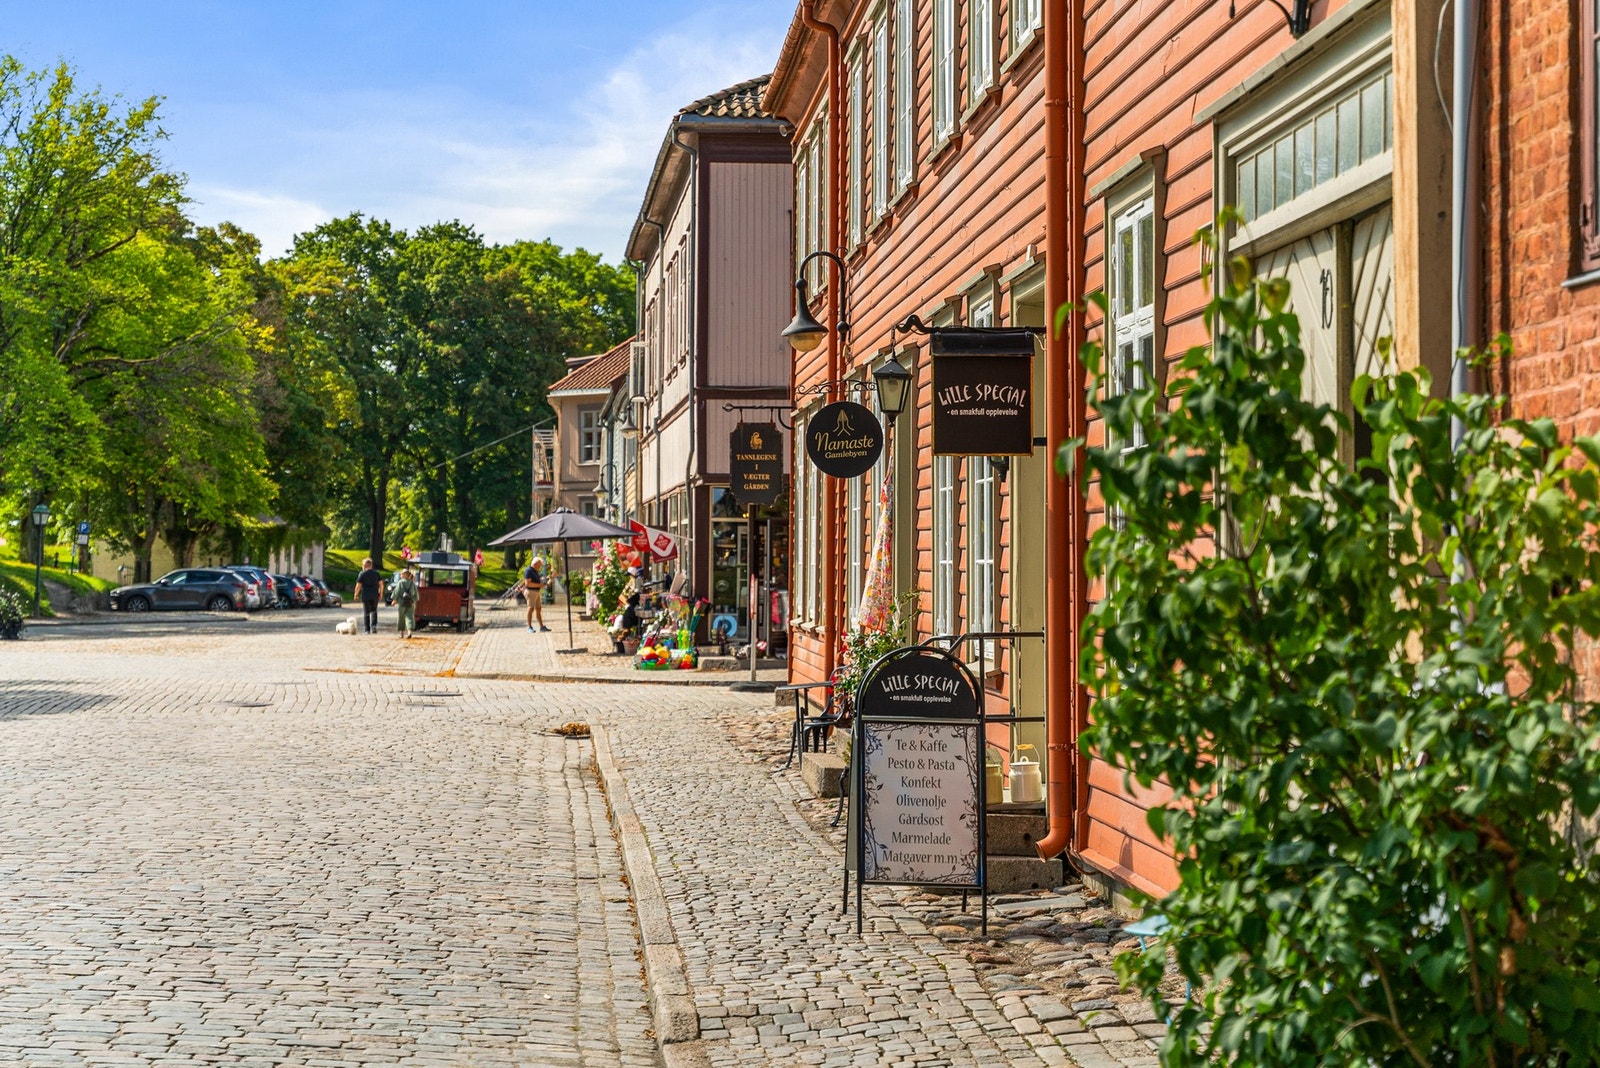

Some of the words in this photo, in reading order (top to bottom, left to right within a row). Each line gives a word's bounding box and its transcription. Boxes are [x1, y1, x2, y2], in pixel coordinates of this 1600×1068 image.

[959, 408, 985, 416] smakfull
[985, 408, 1018, 417] opplevelse
[814, 431, 875, 452] Namaste
[824, 450, 868, 459] Gamlebyen
[743, 482, 770, 490] GÅRDEN
[900, 694, 923, 702] smakfull
[923, 695, 952, 703] opplevelse
[895, 739, 907, 751] Te
[909, 740, 918, 751] &
[920, 740, 948, 752] Kaffe
[887, 757, 915, 769] Pesto
[917, 759, 925, 770] &
[928, 758, 955, 771] Pasta
[901, 776, 942, 789] Konfekt
[896, 793, 947, 811] Olivenolje
[898, 813, 944, 826] Gårdsost
[891, 831, 952, 845] Marmelade
[882, 850, 932, 866] Matgaver
[934, 854, 960, 864] m.m.
